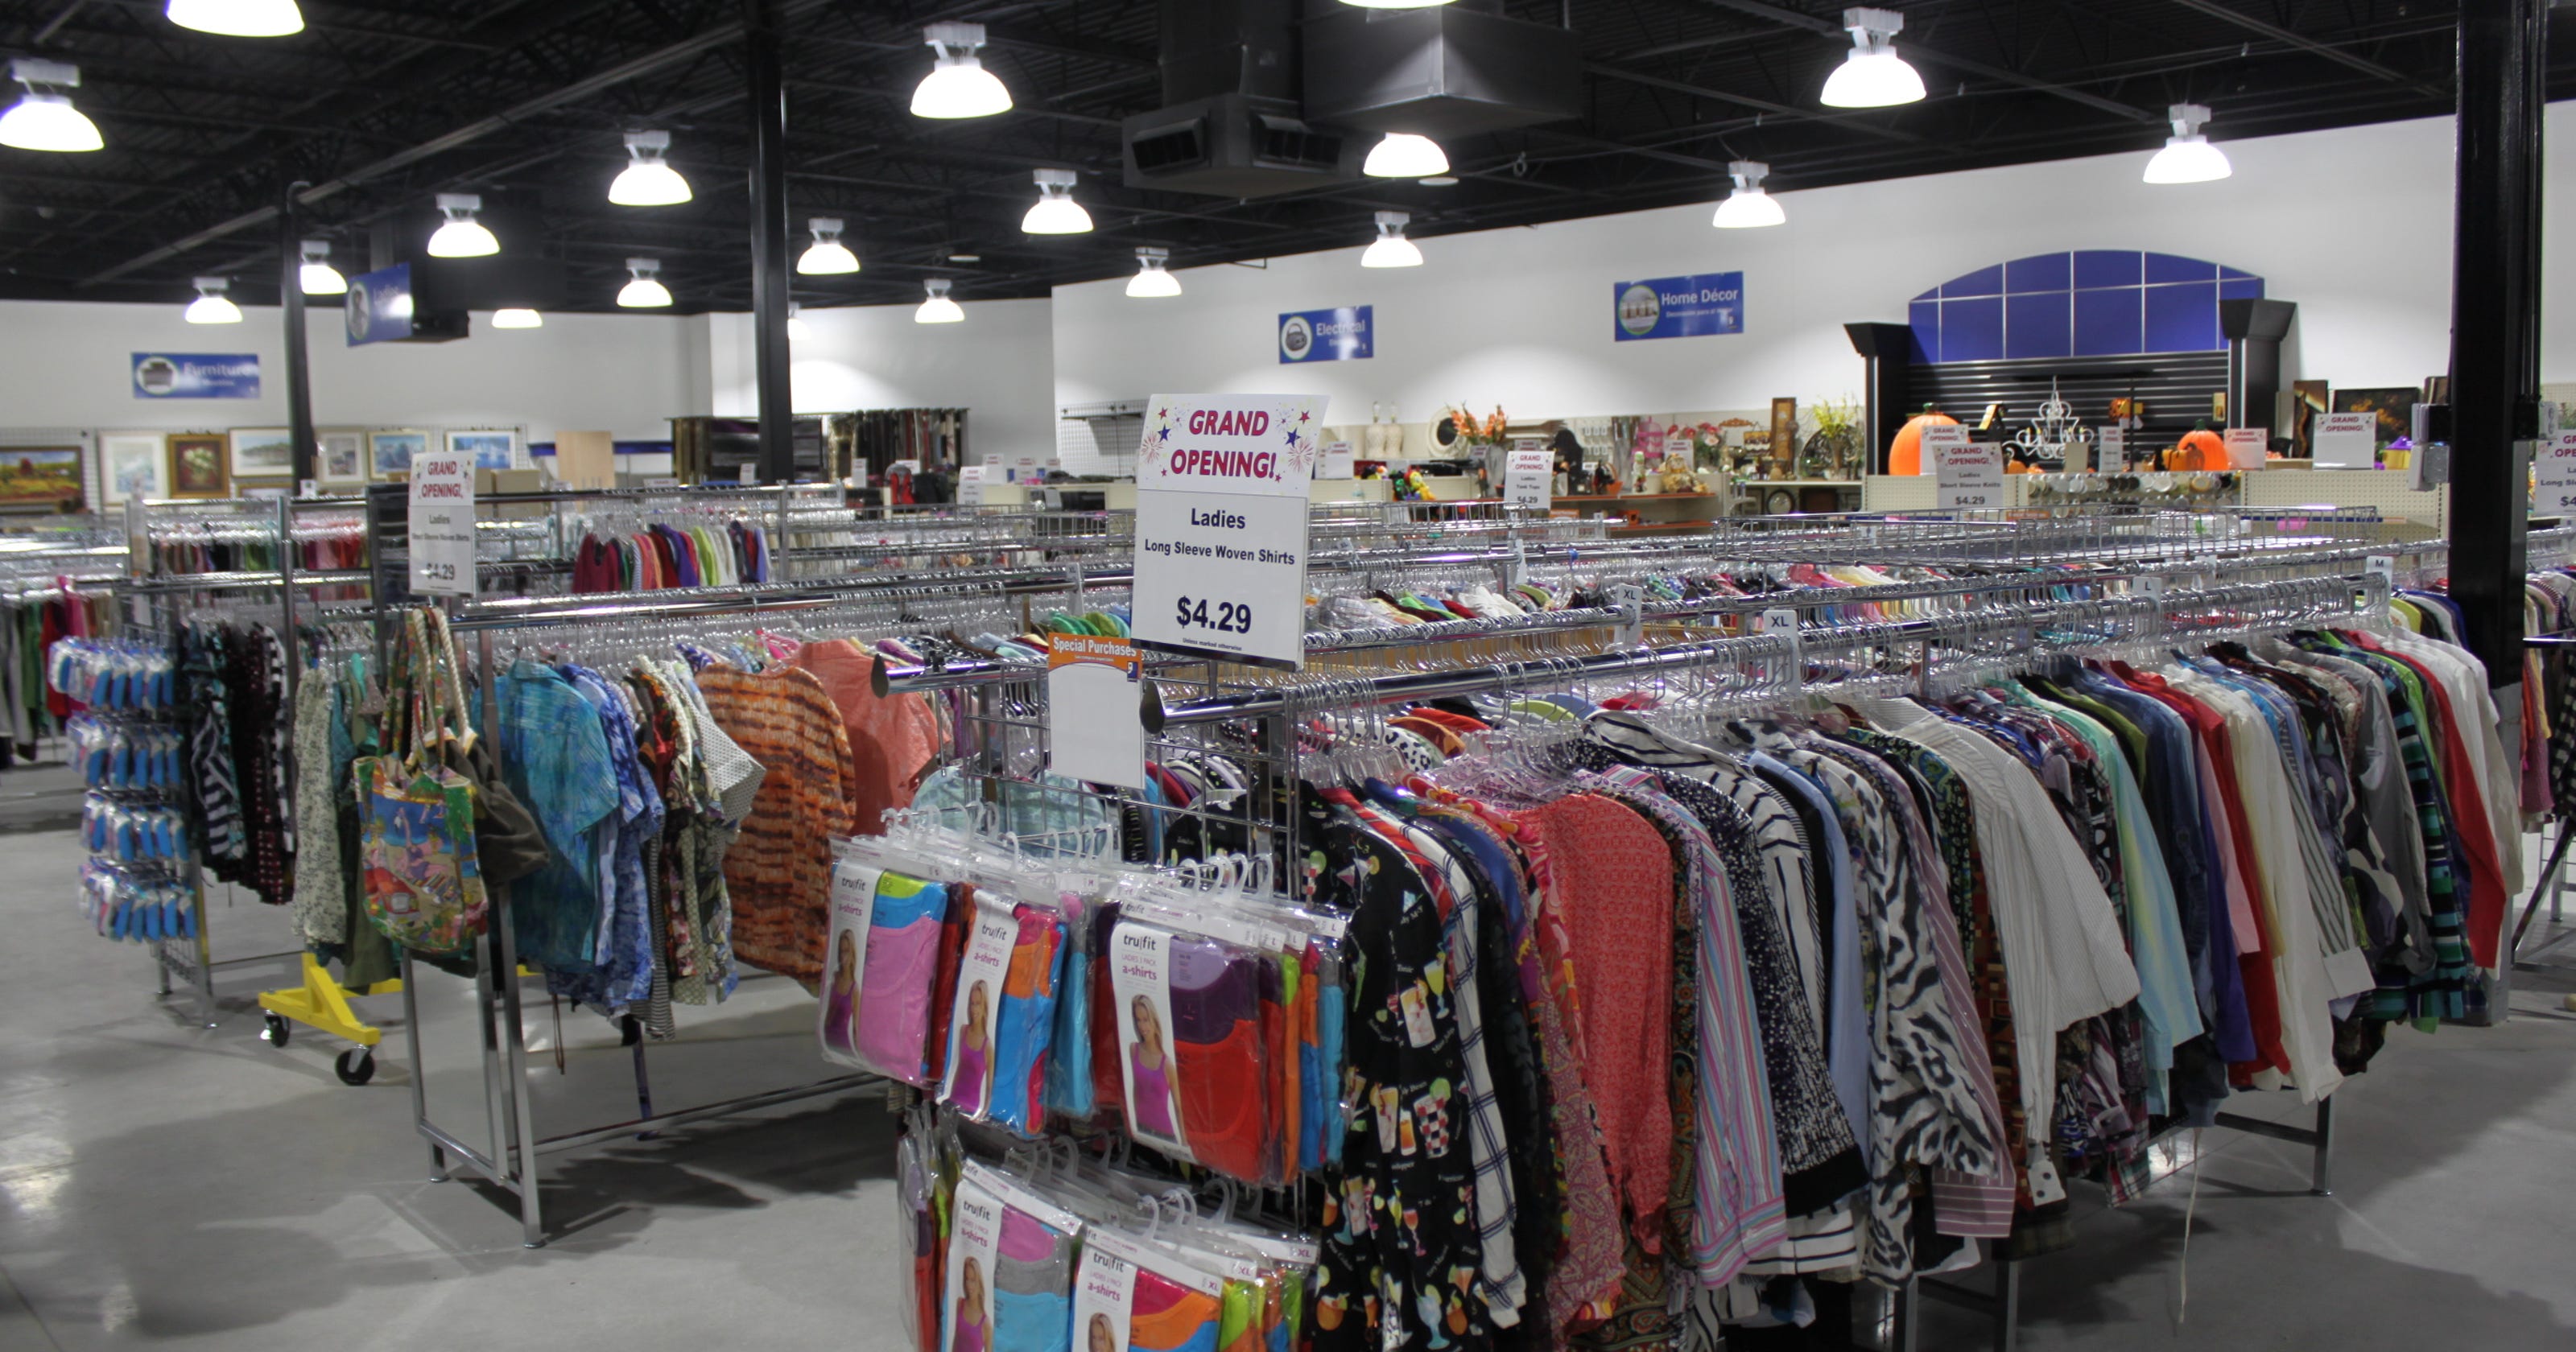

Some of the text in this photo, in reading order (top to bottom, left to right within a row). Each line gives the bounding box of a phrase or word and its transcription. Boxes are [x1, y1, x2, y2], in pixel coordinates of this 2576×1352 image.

[1662, 288, 1738, 305] Home Décor
[1189, 410, 1269, 435] GRAND
[427, 460, 457, 476] GRAND
[1170, 449, 1277, 478] OPENING!
[1955, 496, 1985, 505] $4.29
[429, 514, 450, 525] Ladies
[1191, 508, 1246, 529] Ladies
[1145, 539, 1294, 565] Long Sleeve Woven Shirts
[2376, 559, 2384, 567] M
[427, 563, 455, 581] $4.29
[2145, 581, 2151, 591] L
[1623, 589, 1636, 600] XL
[1176, 596, 1252, 634] $4.29
[1771, 616, 1790, 627] XL
[1053, 636, 1137, 657] Special Purchases
[1122, 965, 1158, 980] a-shirts
[1297, 1248, 1311, 1258] XL
[1239, 1267, 1251, 1276] XL
[1088, 1281, 1121, 1302] a-shirts
[1208, 1280, 1218, 1292] XL
